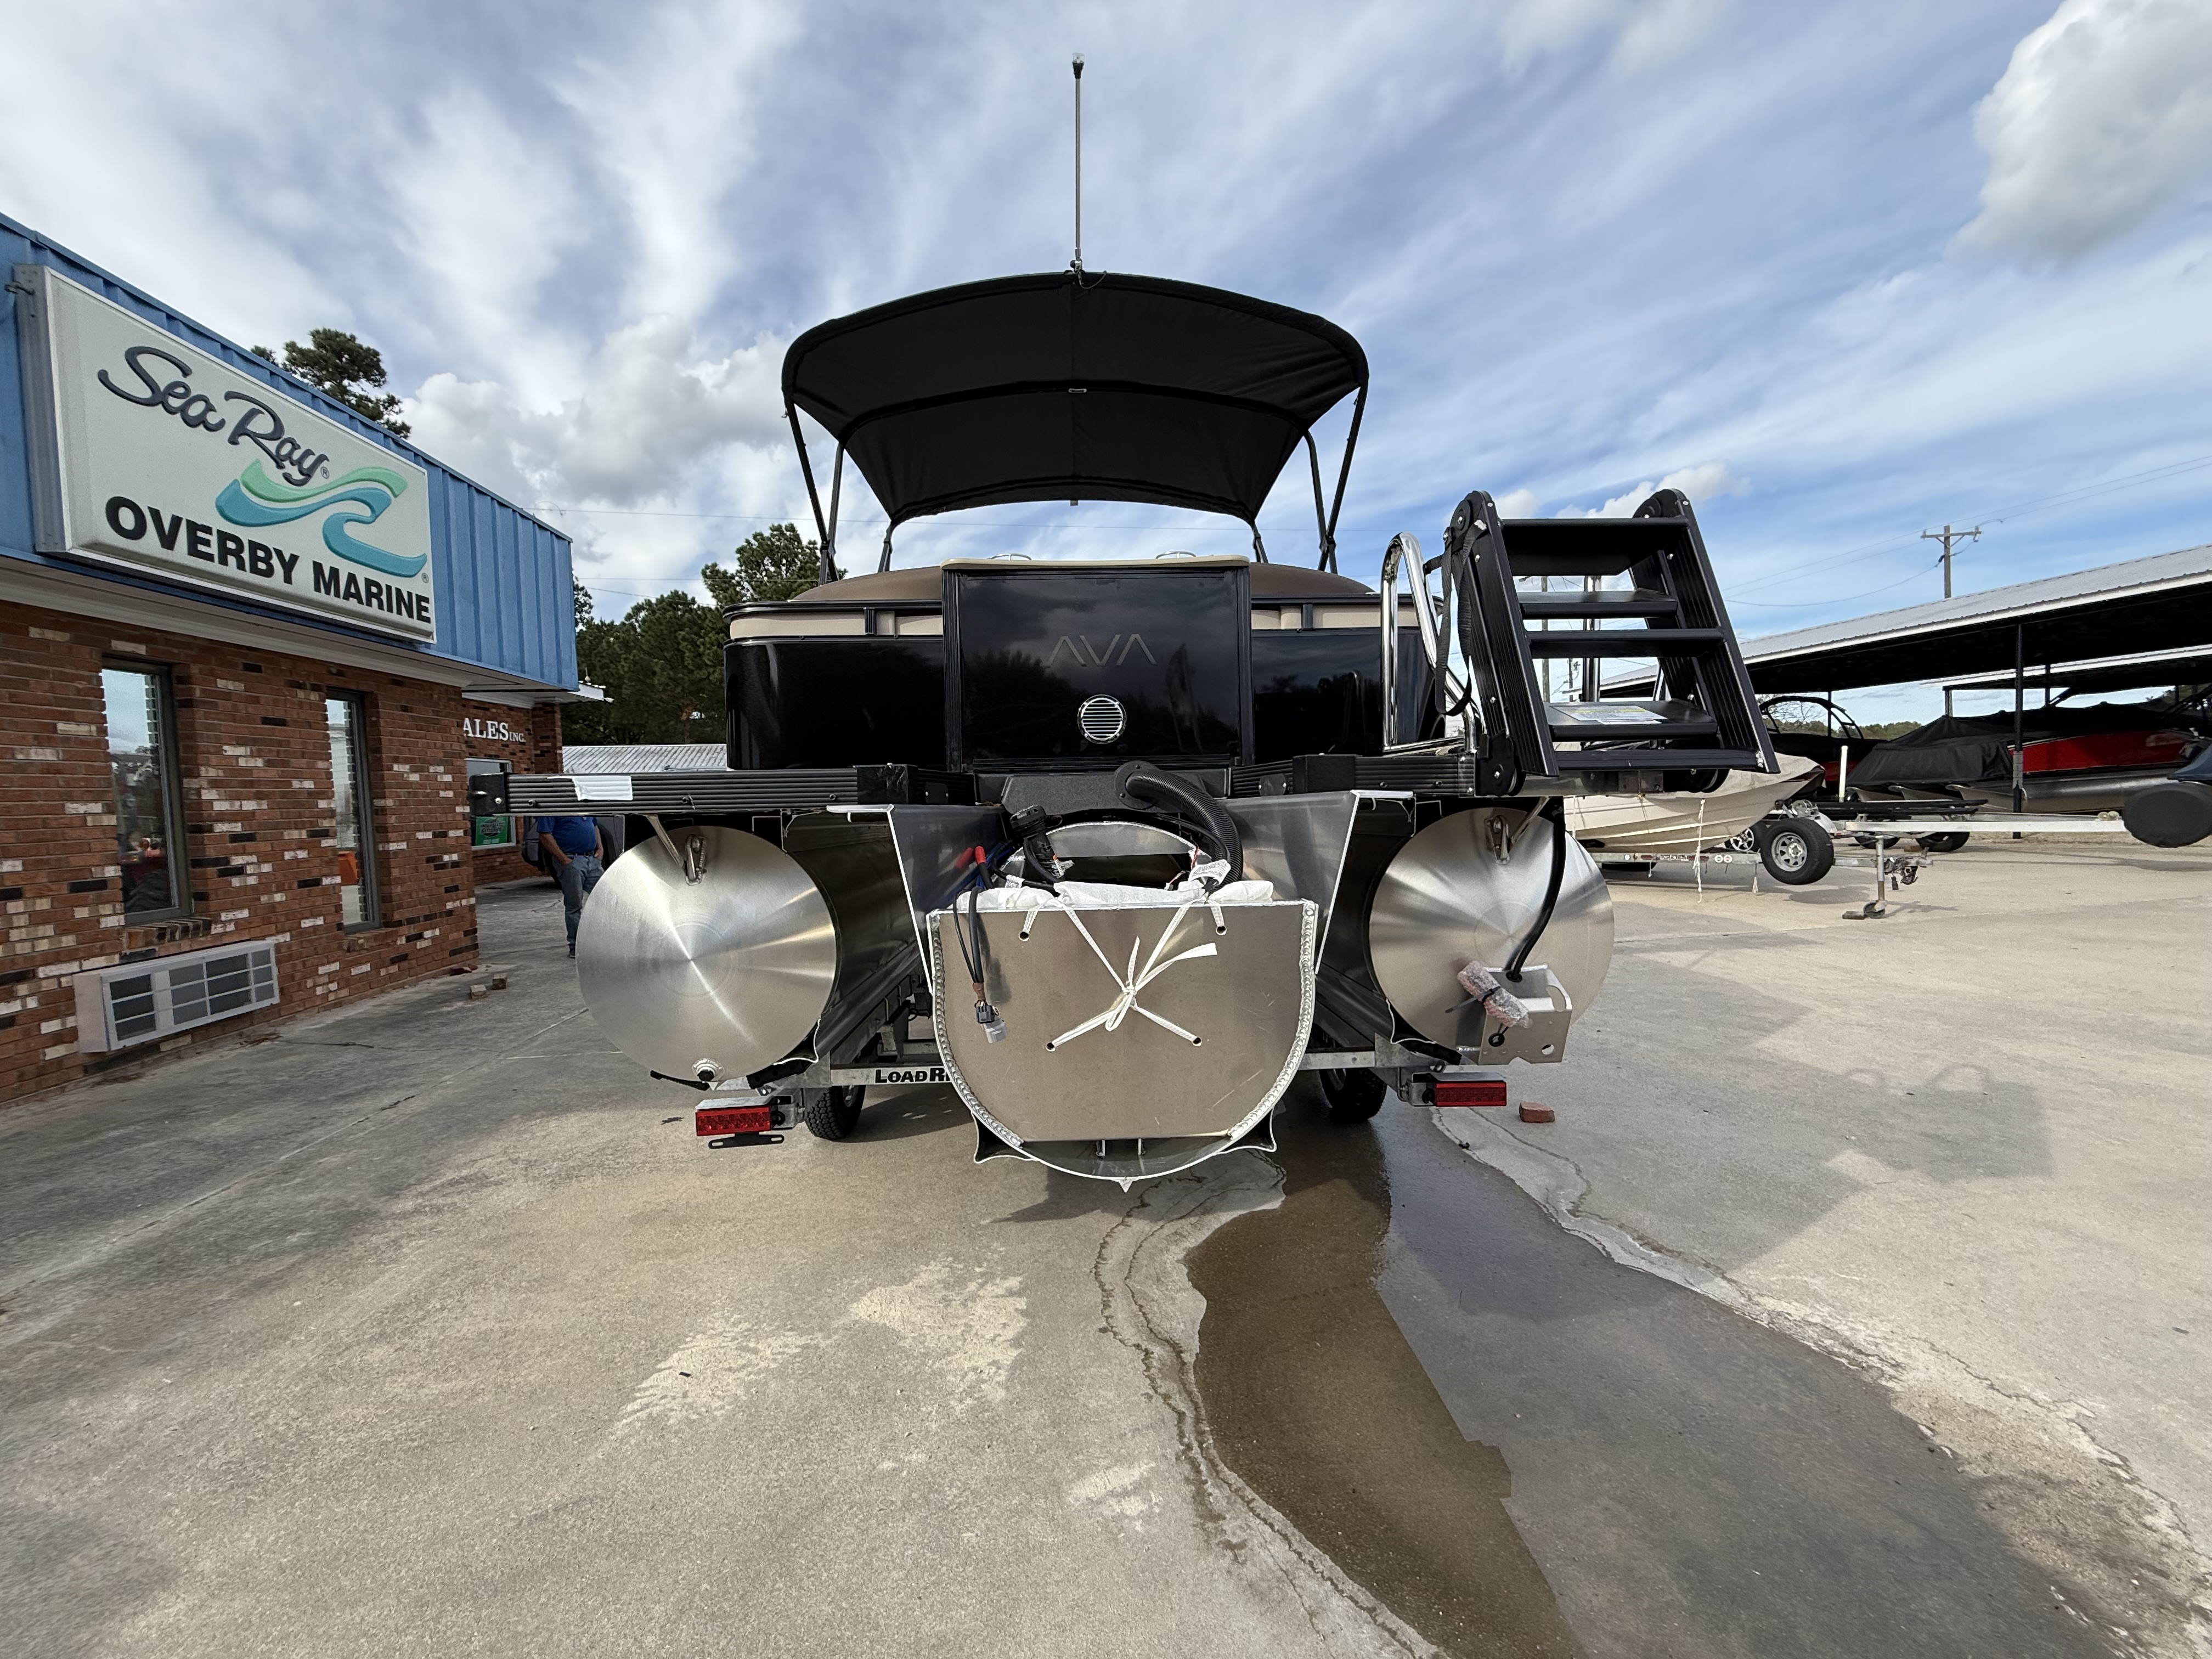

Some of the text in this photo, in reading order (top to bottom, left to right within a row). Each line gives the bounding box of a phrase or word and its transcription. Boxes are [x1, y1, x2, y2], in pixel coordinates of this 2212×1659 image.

[98, 346, 225, 432] Sea
[106, 496, 431, 624] OVERBY MARINE
[1040, 634, 1157, 667] AVA
